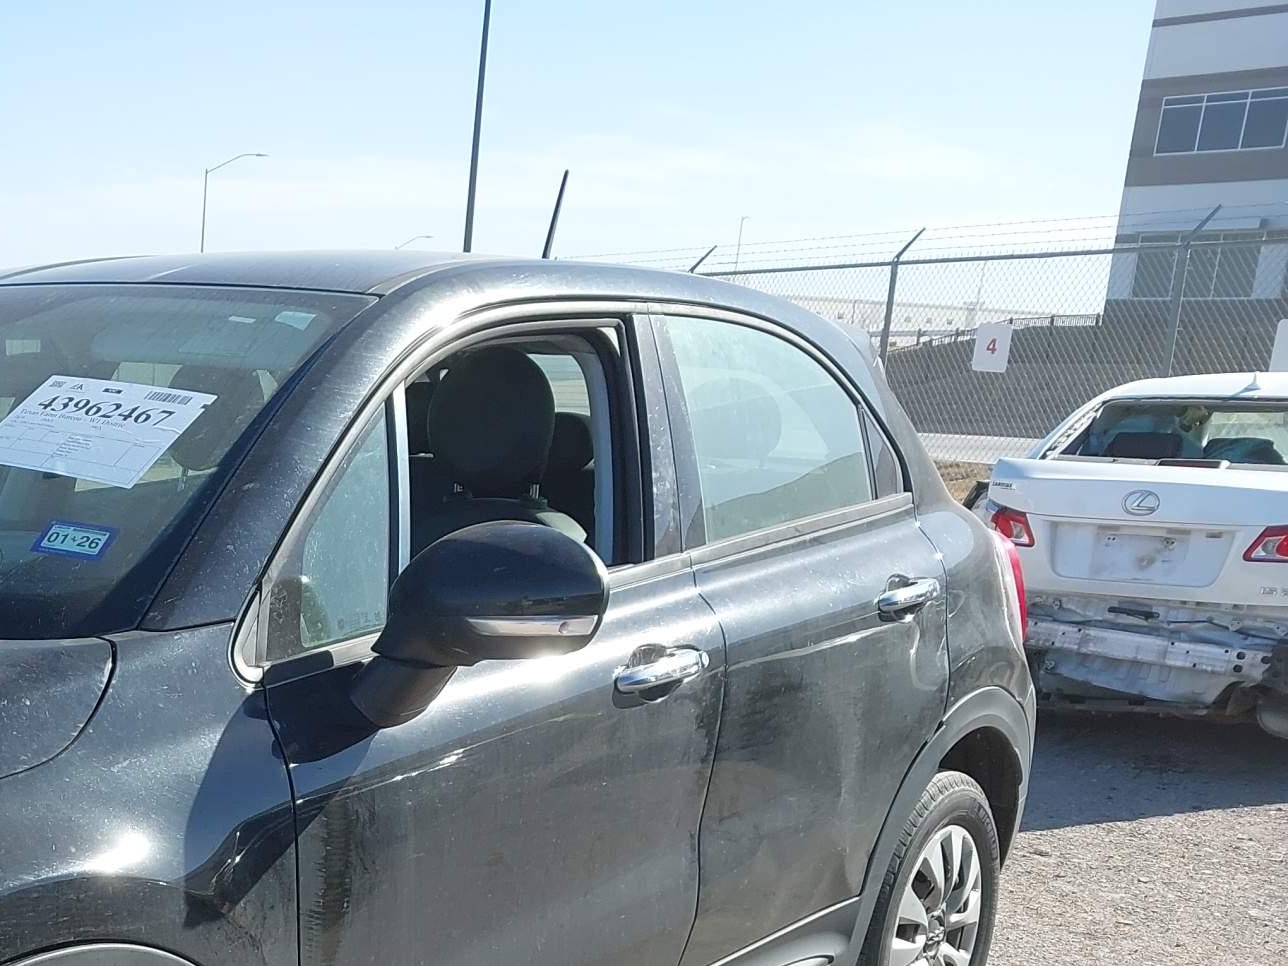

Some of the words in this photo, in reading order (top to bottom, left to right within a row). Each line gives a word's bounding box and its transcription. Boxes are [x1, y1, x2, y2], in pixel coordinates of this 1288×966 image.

[986, 337, 998, 355] 4
[38, 394, 177, 427] 43962467
[47, 531, 70, 545] 01
[76, 535, 102, 550] 26
